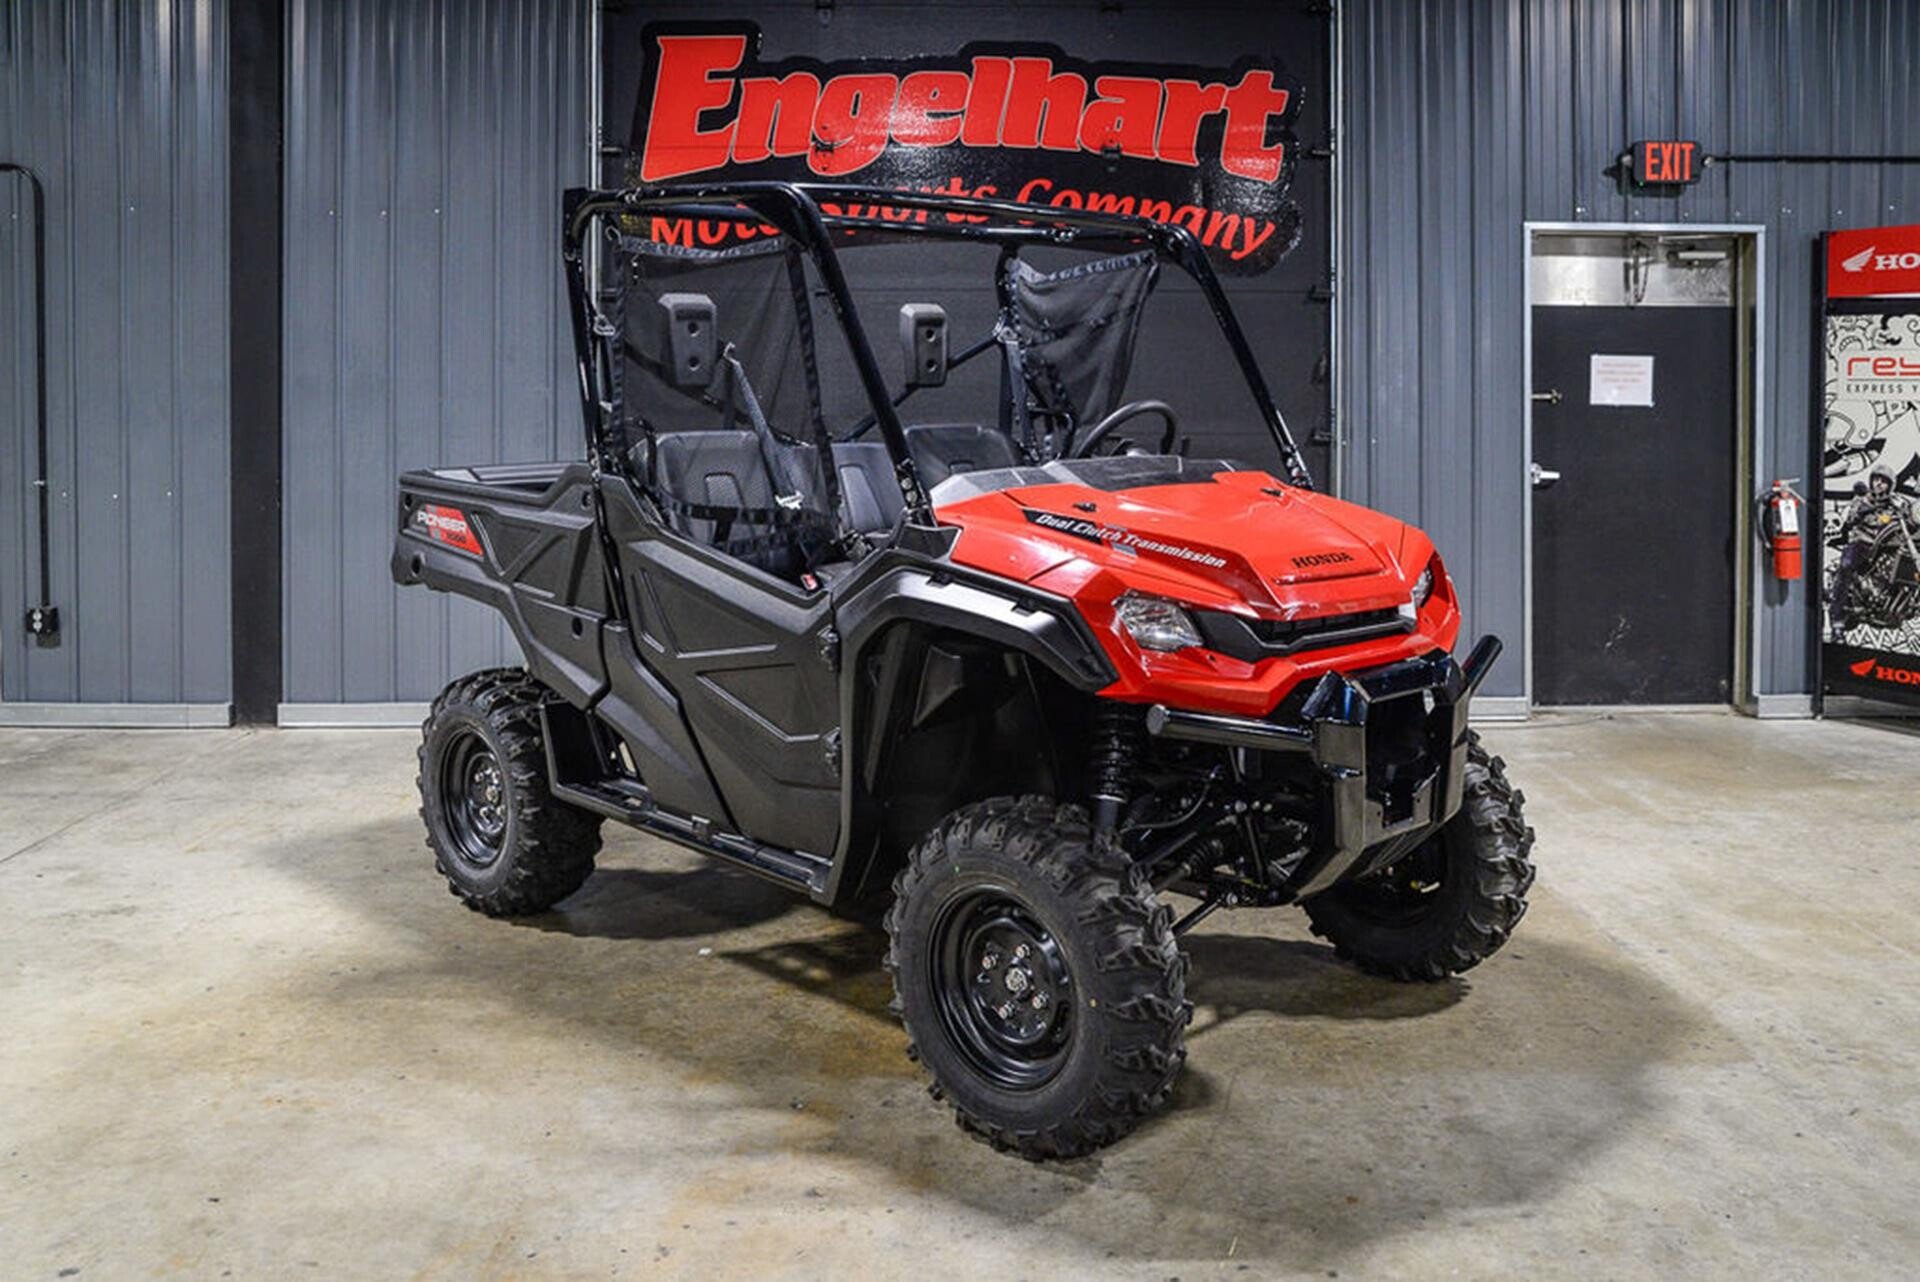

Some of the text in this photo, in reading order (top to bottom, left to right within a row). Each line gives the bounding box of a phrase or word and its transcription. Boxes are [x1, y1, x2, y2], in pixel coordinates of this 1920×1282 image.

[640, 35, 1289, 184] Engelhart
[1645, 141, 1695, 181] EXIT
[1846, 384, 1904, 393] EXPRESS
[1035, 513, 1227, 568] Dual Clutch Transmission
[1291, 552, 1354, 569] HONDA
